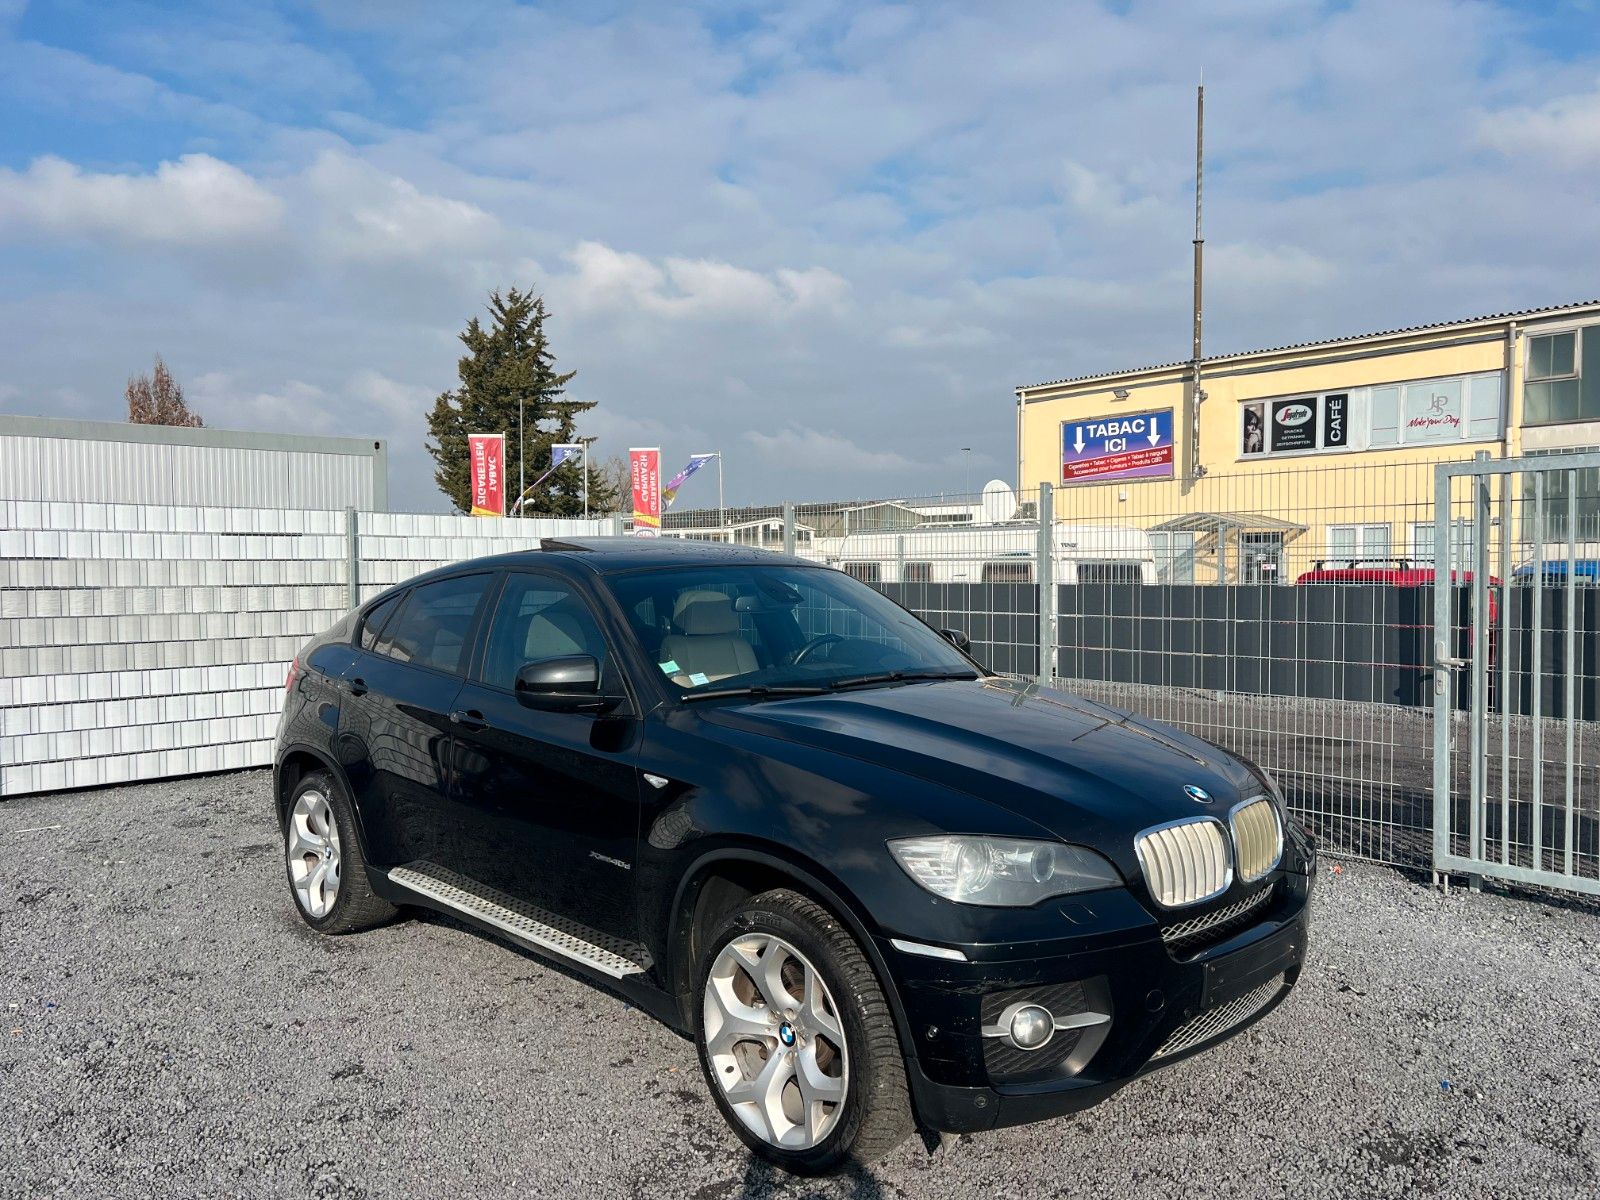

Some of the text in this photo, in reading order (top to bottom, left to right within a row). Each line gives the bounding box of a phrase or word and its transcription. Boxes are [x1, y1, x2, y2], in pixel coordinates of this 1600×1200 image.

[1086, 418, 1146, 438] TABAC
[1329, 399, 1342, 442] CAFÉ
[1104, 437, 1127, 453] ICI
